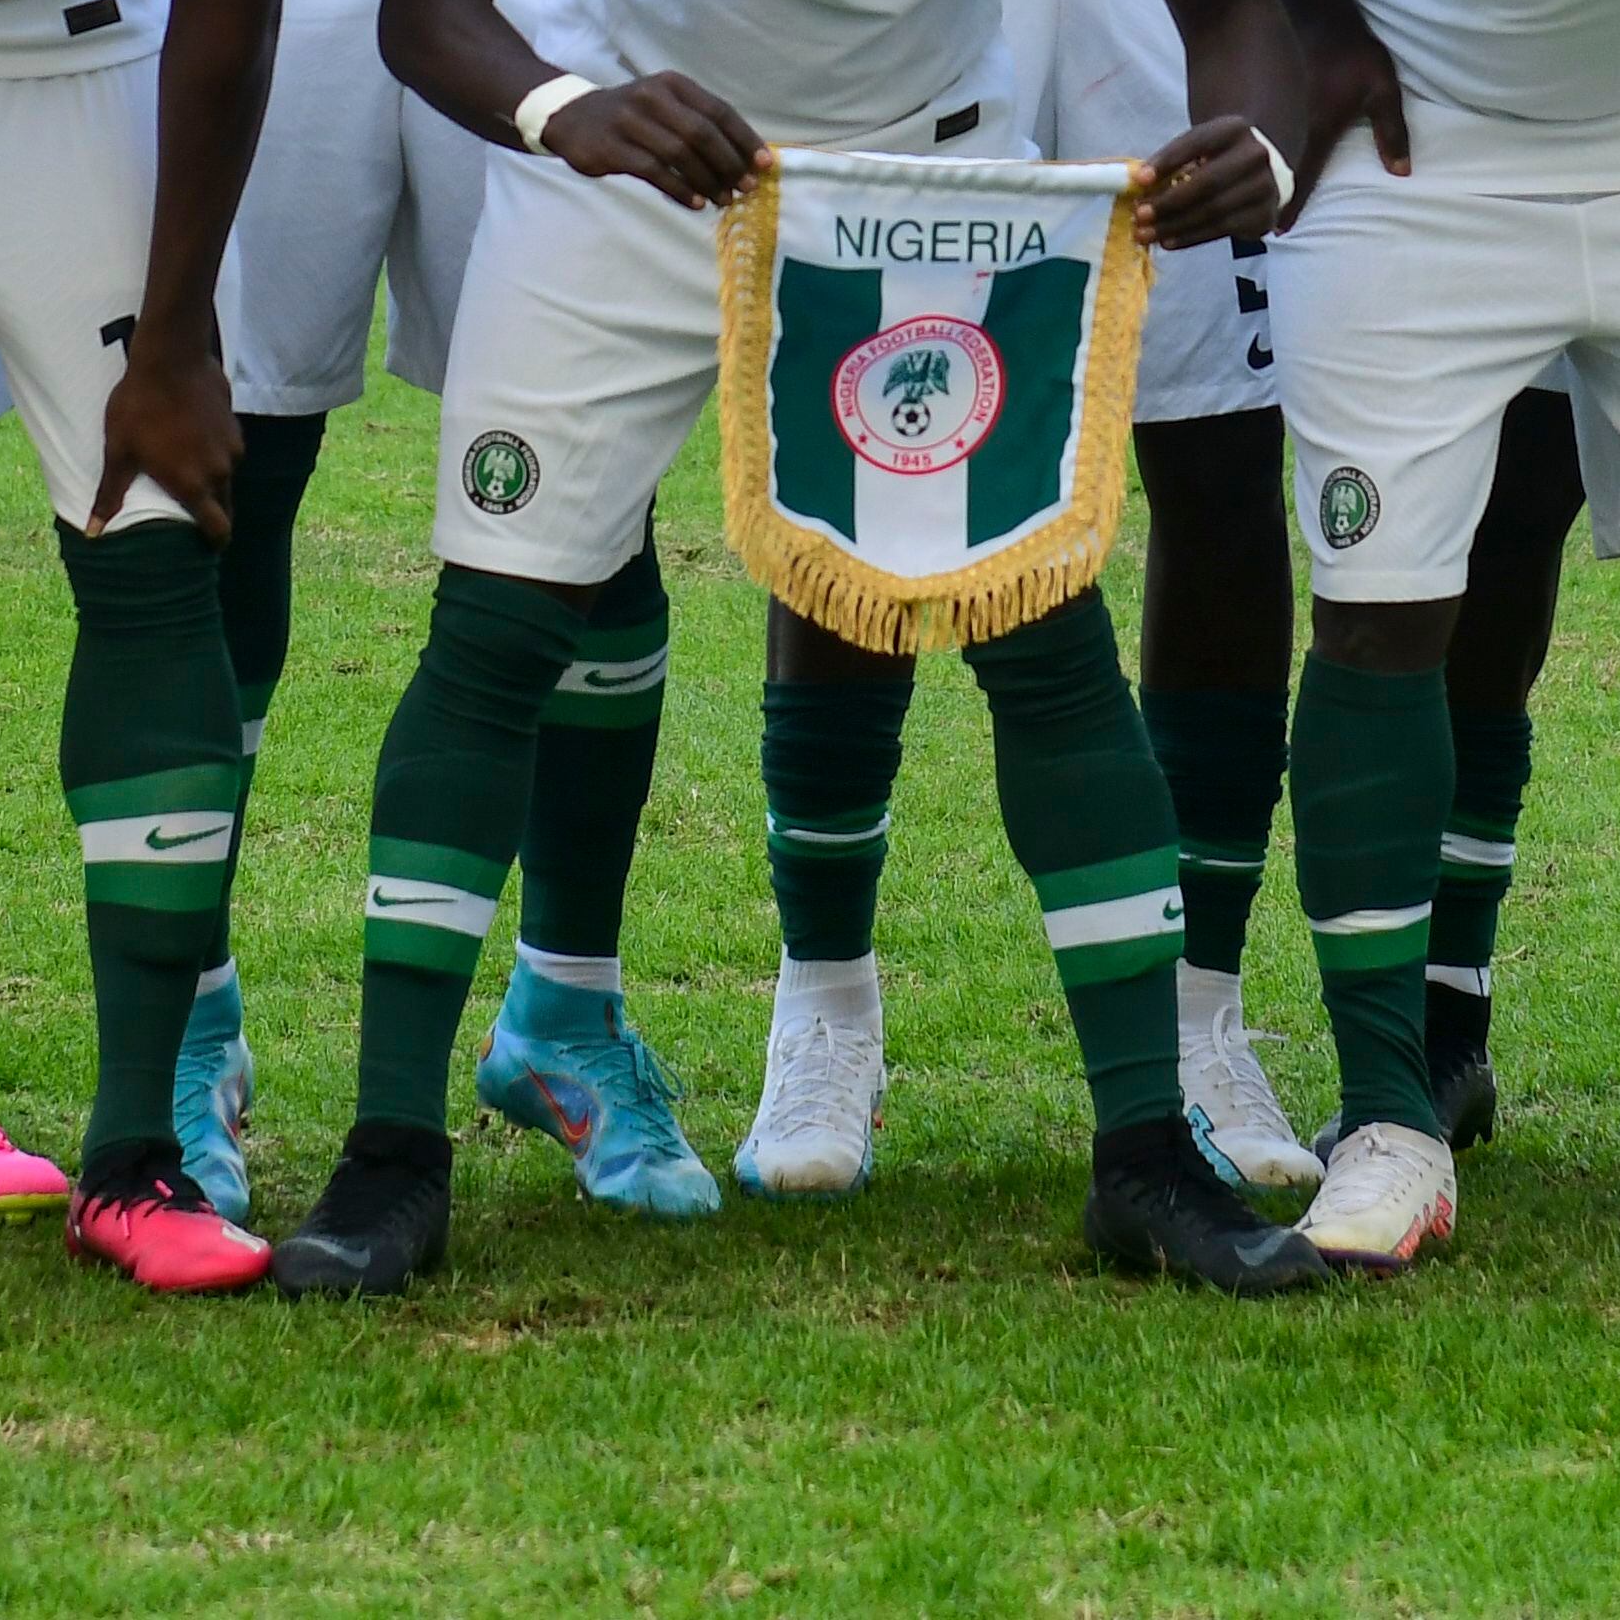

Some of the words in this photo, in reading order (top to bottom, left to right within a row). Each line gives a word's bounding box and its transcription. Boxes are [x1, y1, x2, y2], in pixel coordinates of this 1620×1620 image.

[836, 216, 1047, 263] NIGERIA
[839, 352, 866, 418] NIGERIA
[870, 323, 953, 356] FOOTBALL
[955, 328, 996, 422] FEDERATION
[891, 451, 933, 468] 1945
